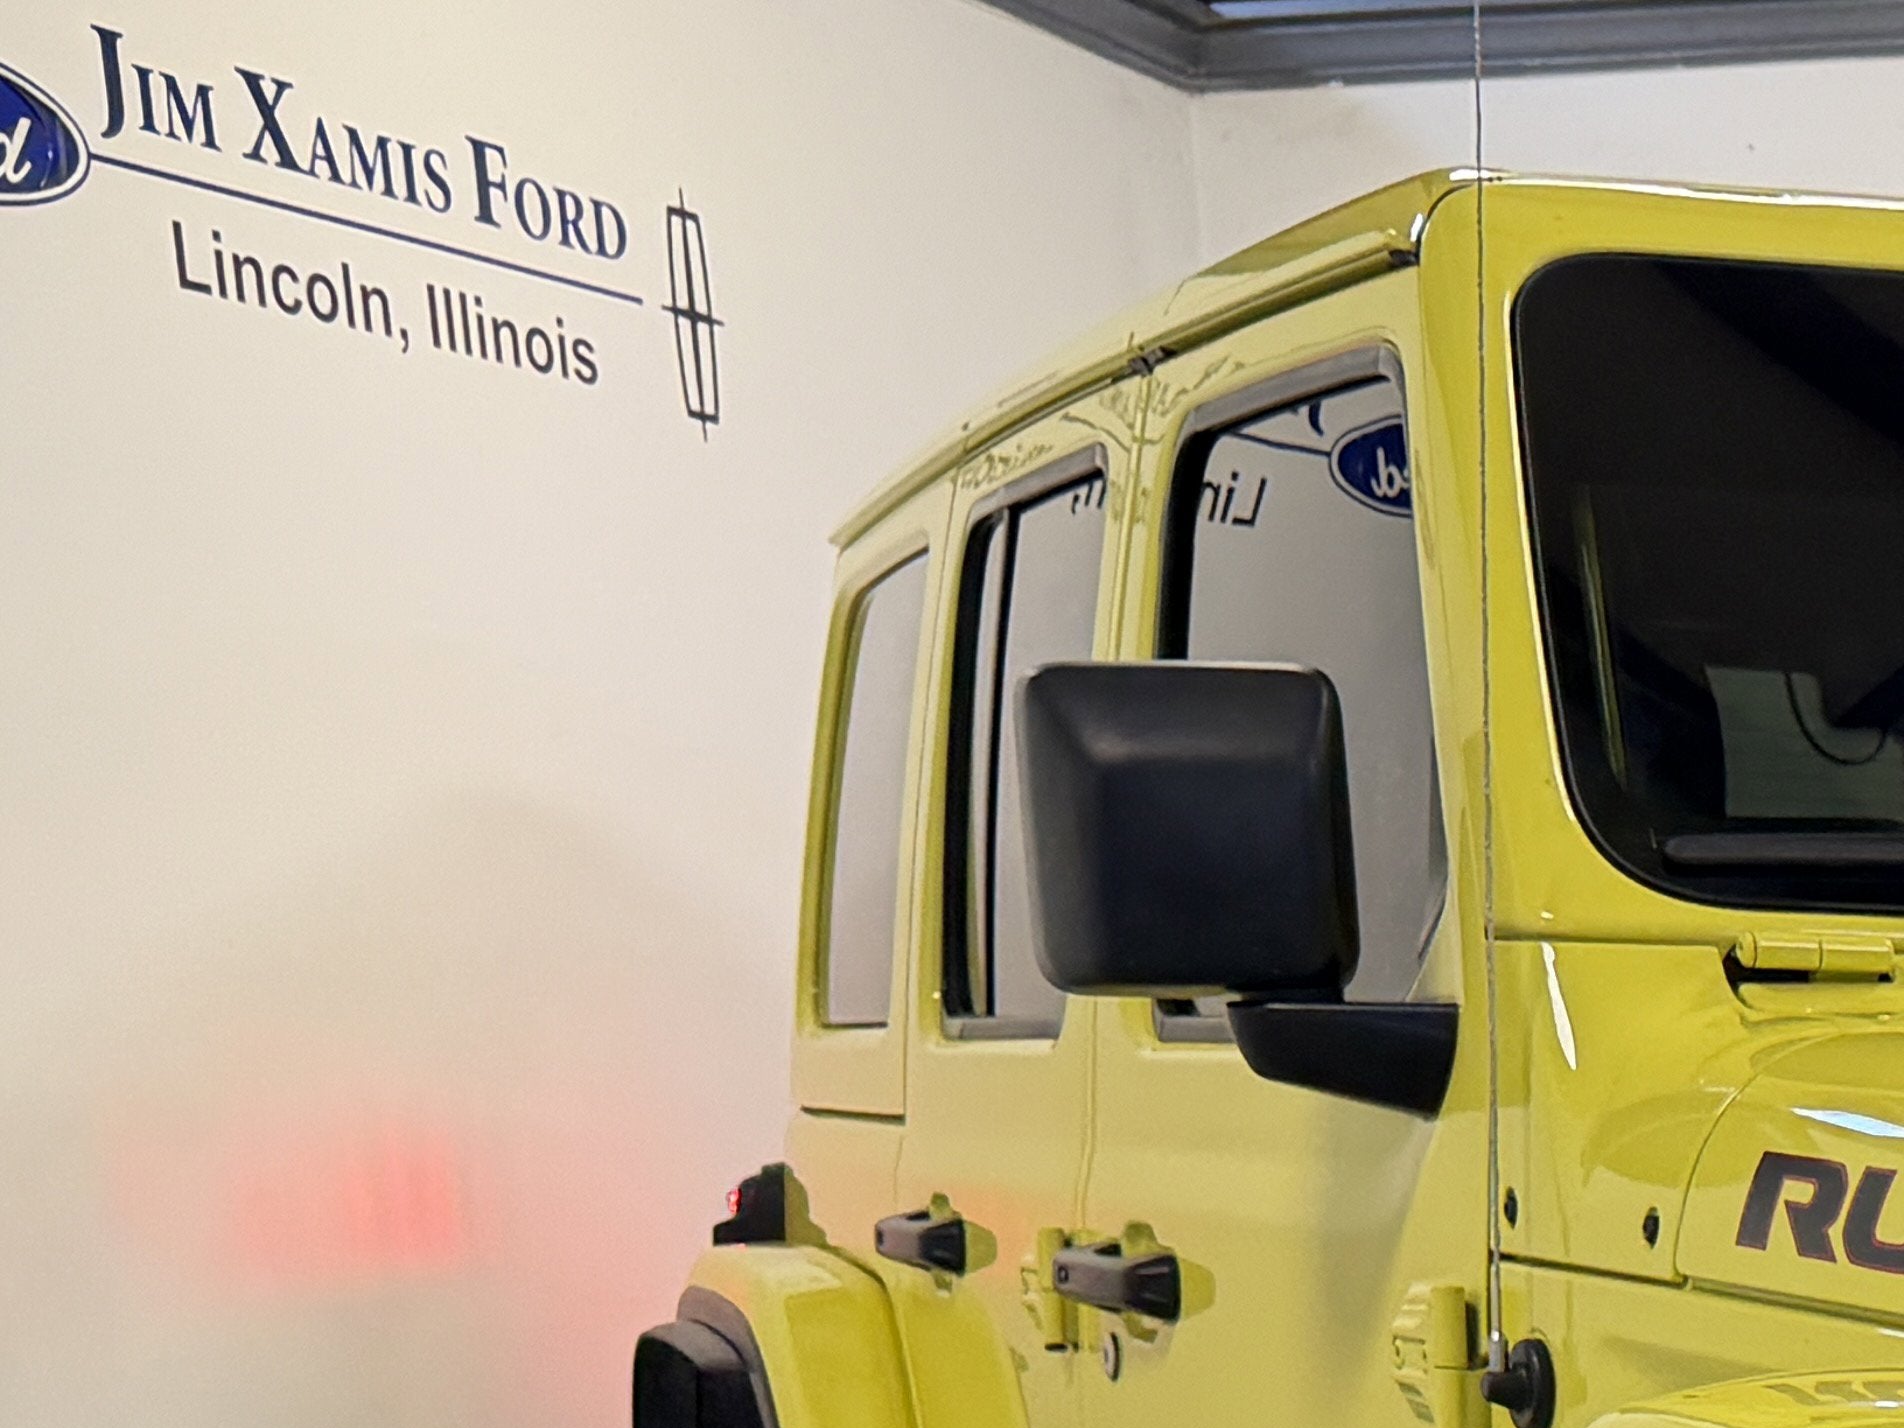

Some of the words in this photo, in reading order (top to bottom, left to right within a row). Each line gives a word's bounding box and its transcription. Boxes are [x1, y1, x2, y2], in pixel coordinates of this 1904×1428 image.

[90, 23, 221, 152] JIM
[234, 66, 452, 213] XAMIS
[465, 135, 627, 260] FORD
[172, 220, 409, 354] Lincoln,
[426, 284, 598, 385] Illinois
